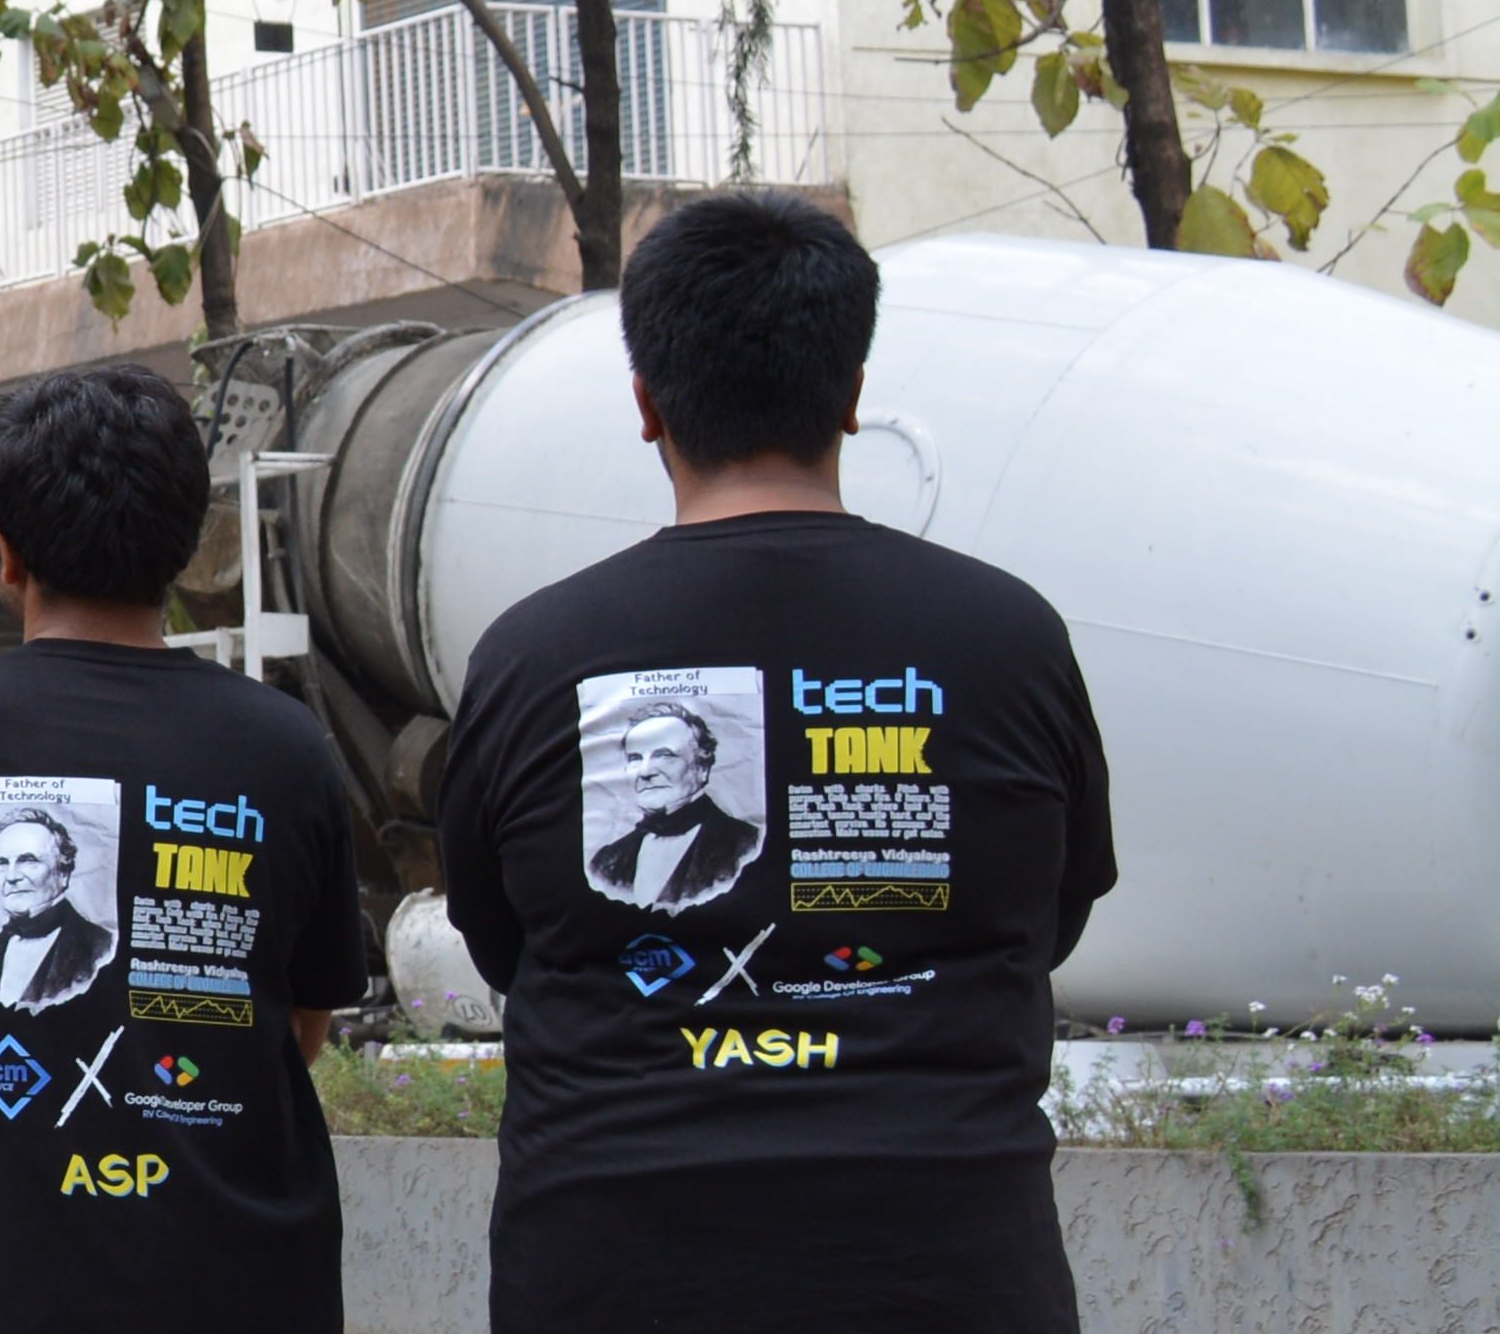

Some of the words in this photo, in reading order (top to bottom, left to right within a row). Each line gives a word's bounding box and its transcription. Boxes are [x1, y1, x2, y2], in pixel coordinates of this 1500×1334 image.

[634, 672, 681, 683] Father
[686, 670, 700, 680] of
[630, 684, 708, 696] Technology
[792, 667, 943, 715] tech
[805, 727, 933, 774] TANK
[4, 778, 47, 788] Father
[51, 779, 65, 788] of
[0, 791, 71, 803] Technology
[145, 784, 264, 843] tech
[791, 848, 876, 862] Rashtreeya
[881, 849, 950, 864] Vidyalaya
[152, 842, 254, 897] TANK
[772, 981, 821, 994] Google
[679, 1027, 840, 1069] YASH
[208, 1100, 243, 1114] Group
[60, 1153, 169, 1198] ASP
